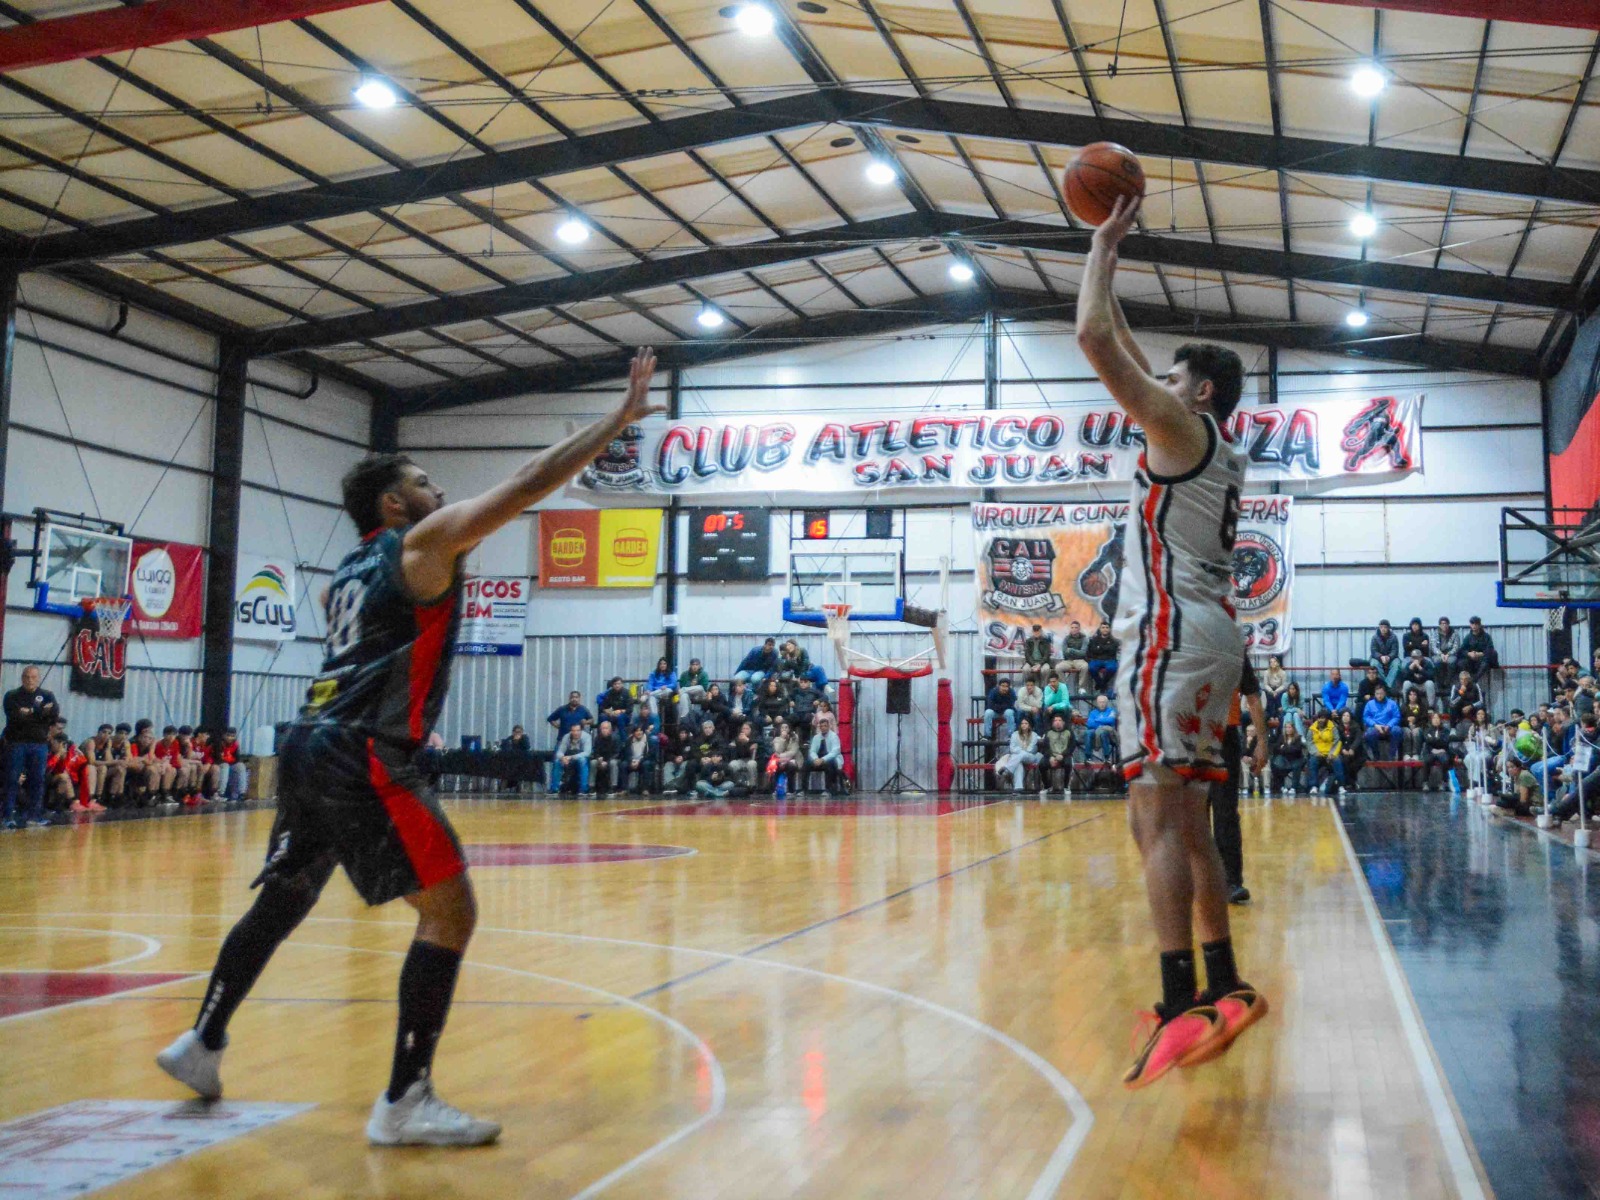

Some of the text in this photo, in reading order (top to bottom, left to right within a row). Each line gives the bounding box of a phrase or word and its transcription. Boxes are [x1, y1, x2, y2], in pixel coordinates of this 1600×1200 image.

[658, 409, 1320, 486] CLUB ATLETICO URIZA
[854, 452, 1113, 484] SAN JUAN
[973, 504, 1067, 528] URQUIZA
[1072, 504, 1131, 522] CUNA
[995, 540, 1047, 557] CAU
[998, 580, 1047, 595] PANTERAS
[996, 592, 1050, 608] SAN JUAN
[76, 628, 127, 679] CAU
